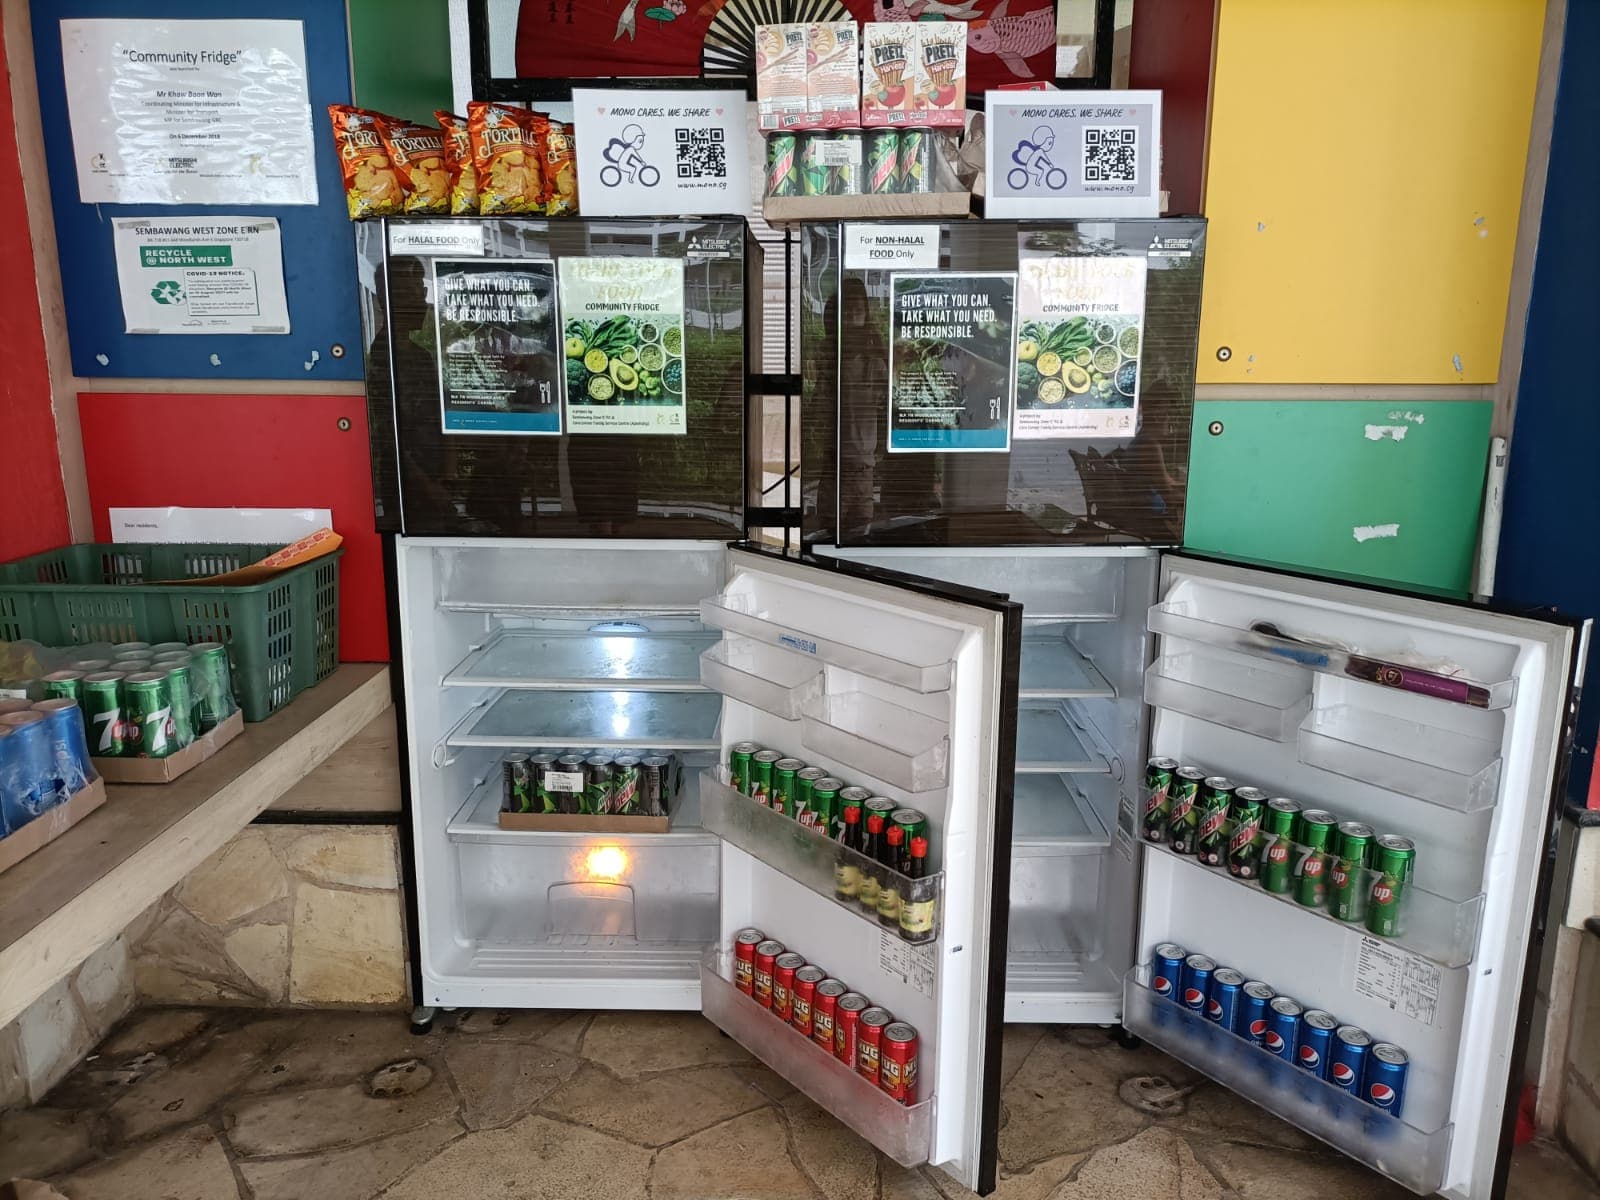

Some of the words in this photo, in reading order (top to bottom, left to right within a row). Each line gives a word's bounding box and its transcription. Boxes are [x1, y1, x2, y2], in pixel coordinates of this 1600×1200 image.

[786, 32, 803, 44] PRETZ
[837, 30, 854, 42] PRETZ
[874, 45, 905, 64] PRETZ
[925, 45, 956, 63] PRETZ
[156, 90, 166, 98] Mr
[610, 108, 636, 117] MONO
[667, 108, 681, 117] WE
[682, 108, 711, 117] SHARE
[1021, 109, 1048, 118] MONO
[1079, 109, 1094, 118] WE
[1094, 108, 1124, 118] SHARE
[135, 226, 191, 236] SEMBAWANG
[192, 226, 215, 235] WEST
[216, 226, 240, 235] ZONE
[393, 236, 407, 244] For
[408, 236, 434, 245] HALAL
[436, 236, 460, 245] FOOD
[461, 236, 480, 246] Only
[860, 236, 873, 245] For
[875, 236, 925, 246] NON-HALAL
[145, 249, 193, 257] RECYCLE
[869, 250, 894, 259] FOOD
[895, 250, 915, 259] Only
[159, 256, 195, 264] NORTH
[196, 256, 227, 264] WEST
[444, 278, 464, 291] GIVE
[466, 278, 491, 291] WHAT
[493, 278, 511, 292] YOU
[444, 293, 467, 306] TAKE
[469, 293, 495, 307] WHAT
[497, 294, 515, 307] YOU
[515, 294, 541, 307] NEED.
[901, 294, 922, 307] GIVE
[923, 294, 949, 307] WHAT
[951, 294, 969, 307] YOU
[970, 294, 991, 306] CAN.
[585, 302, 632, 311] COMMUNITY
[632, 303, 660, 312] FRIDGE
[1042, 303, 1090, 312] COMMUNITY
[1091, 303, 1120, 312] FRIDGE
[446, 309, 458, 321] BE
[459, 308, 519, 322] RESPONSIBLE.
[901, 310, 924, 323] TAKE
[925, 310, 951, 323] WHAT
[953, 310, 970, 322] YOU
[972, 309, 998, 323] NEED.
[901, 325, 912, 338] BE
[914, 325, 975, 338] RESPONSIBLE.
